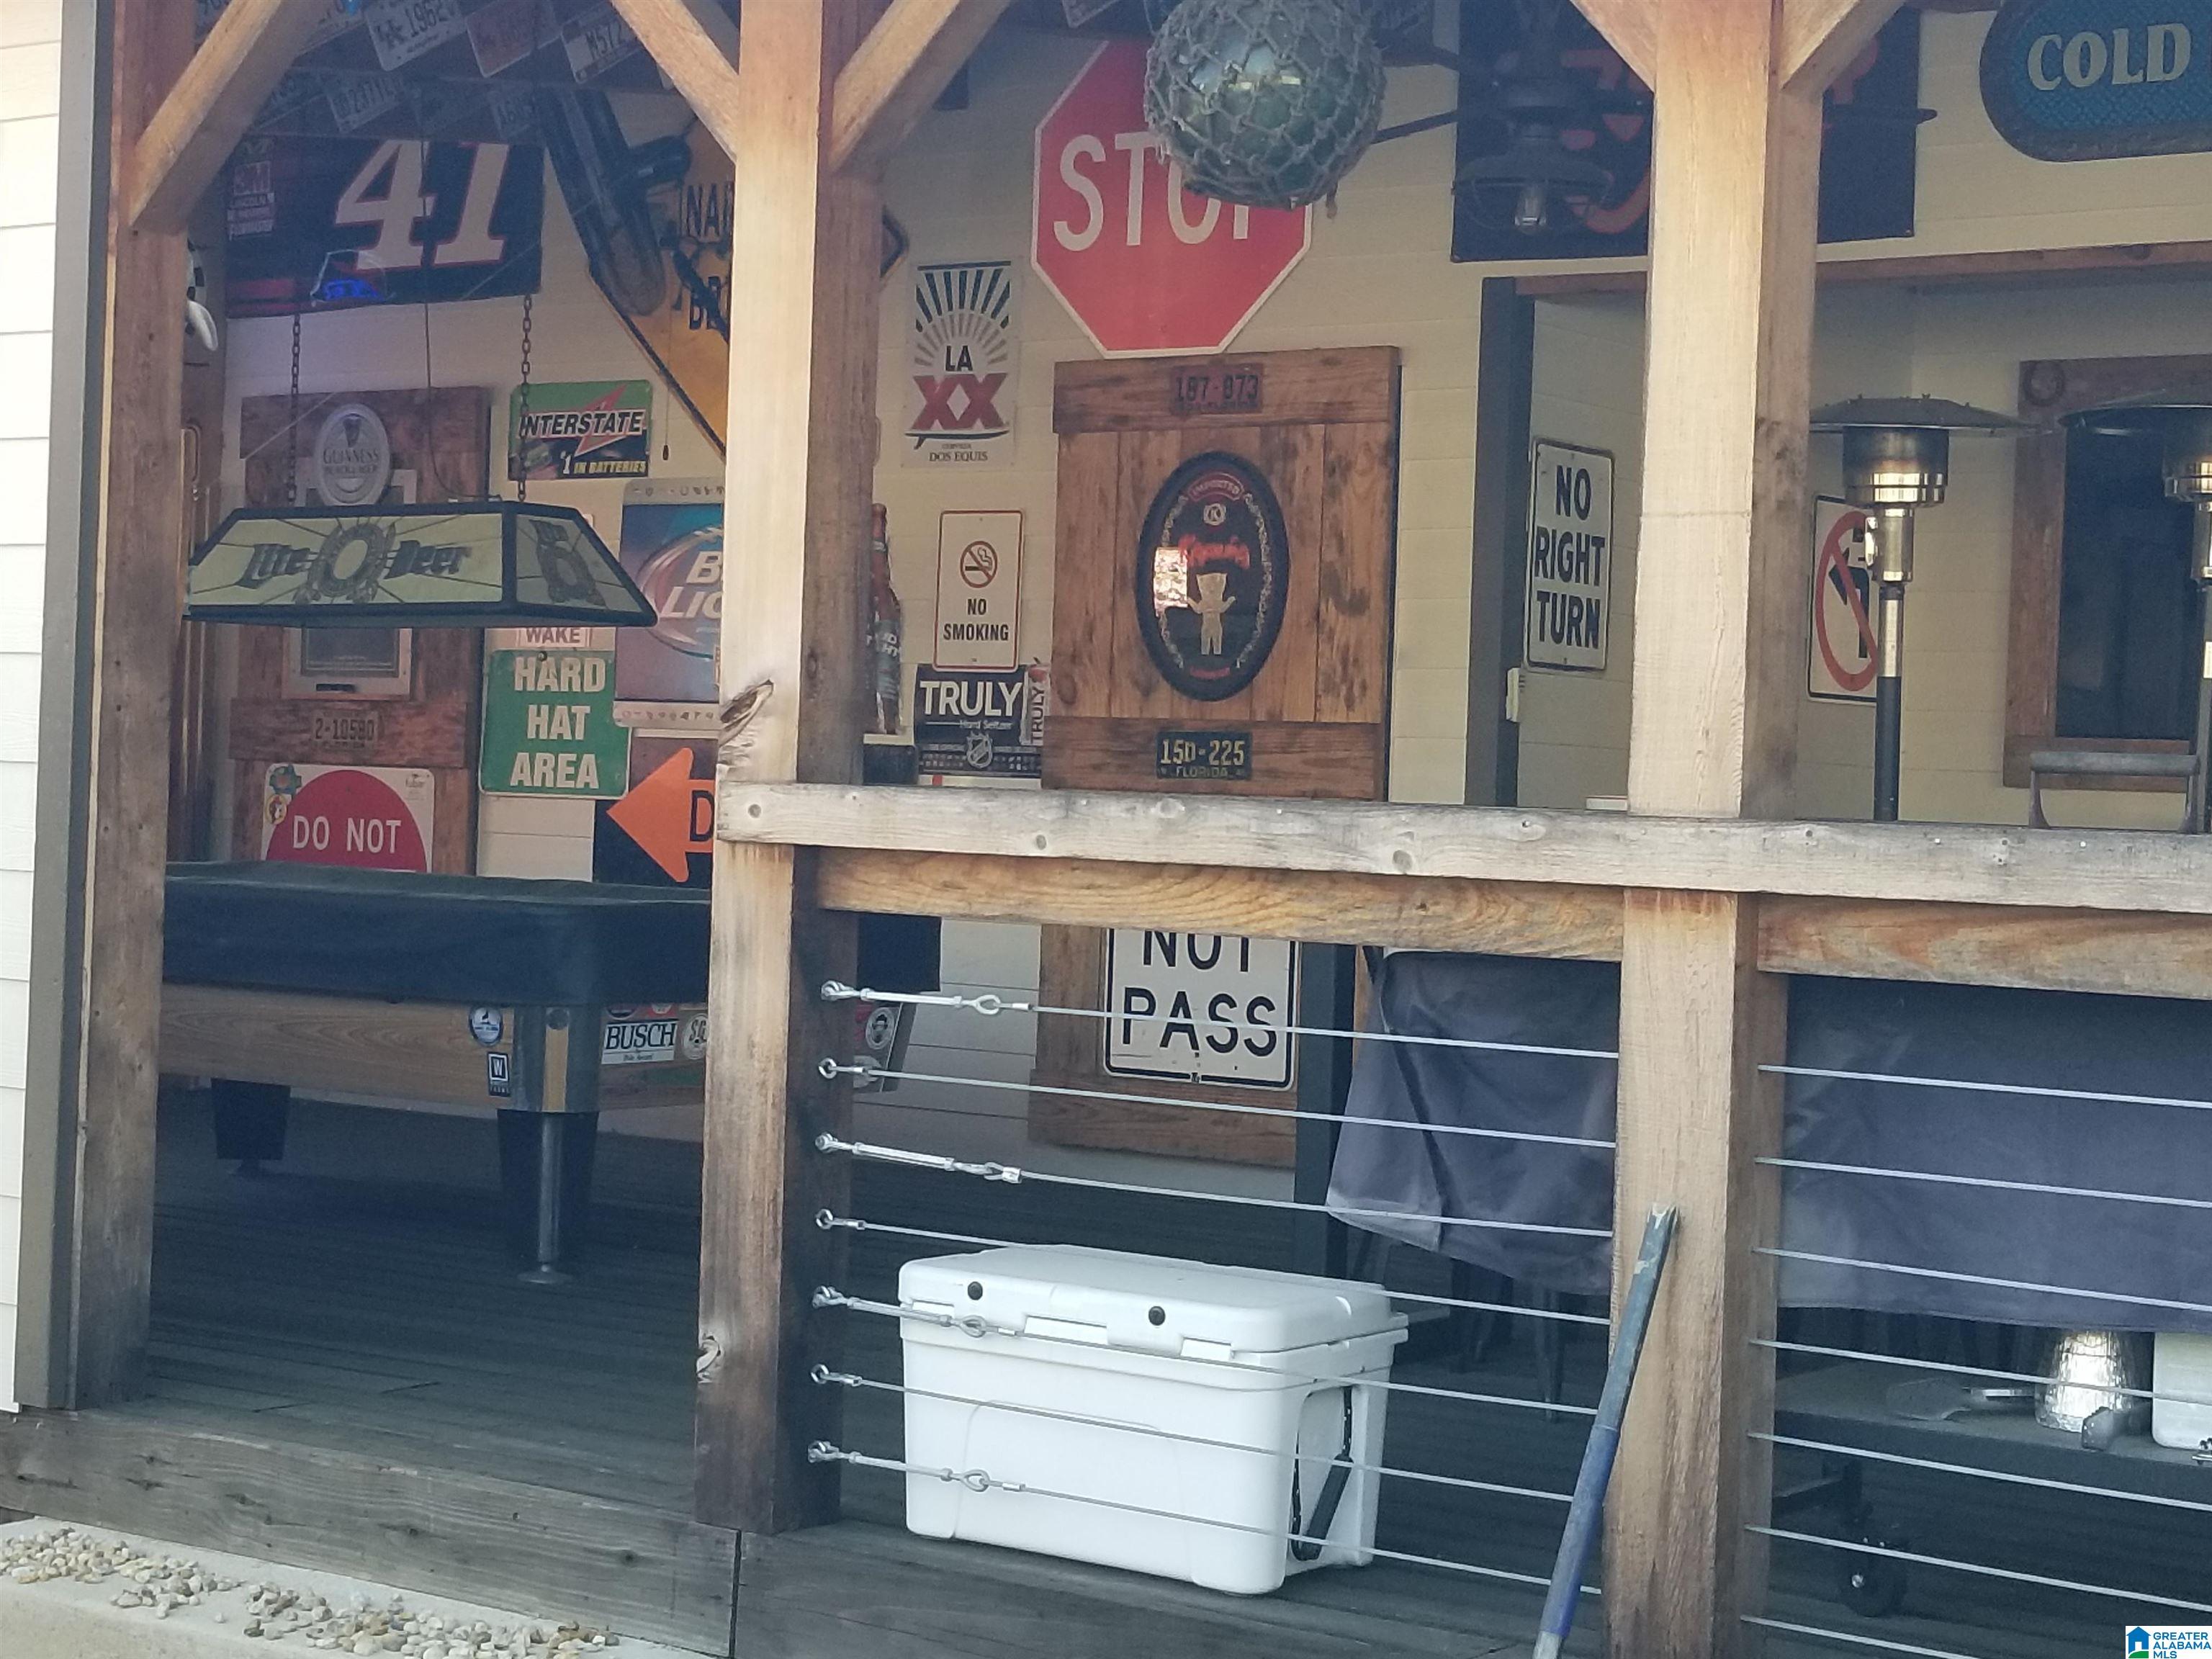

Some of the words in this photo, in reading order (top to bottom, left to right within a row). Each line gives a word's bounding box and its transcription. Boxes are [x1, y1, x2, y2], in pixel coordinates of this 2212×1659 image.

[2028, 23, 2191, 91] COLD
[334, 139, 511, 271] 41
[1053, 131, 1249, 251] STO
[945, 345, 974, 372] LA
[911, 373, 1008, 431] XX
[519, 411, 644, 437] INTERSTATE
[589, 461, 647, 473] BATTERIES
[929, 451, 951, 462] DOS
[954, 450, 989, 463] EQUIS
[1555, 465, 1592, 521] NO
[1534, 525, 1606, 587] RIGHT
[967, 598, 987, 616] NO
[1536, 590, 1601, 649] TURN
[526, 626, 581, 644] WAKE
[942, 623, 1010, 642] SMOKING
[514, 656, 606, 693] HARD
[920, 680, 1023, 717] TRULY
[1030, 685, 1046, 745] TRULY
[527, 704, 591, 741] HAT
[510, 752, 600, 789] AREA
[1175, 765, 1228, 778] FLORIDA
[292, 814, 330, 851] DO
[346, 817, 402, 854] NOT
[606, 1022, 677, 1051] BUSCH
[1122, 986, 1277, 1057] PASS
